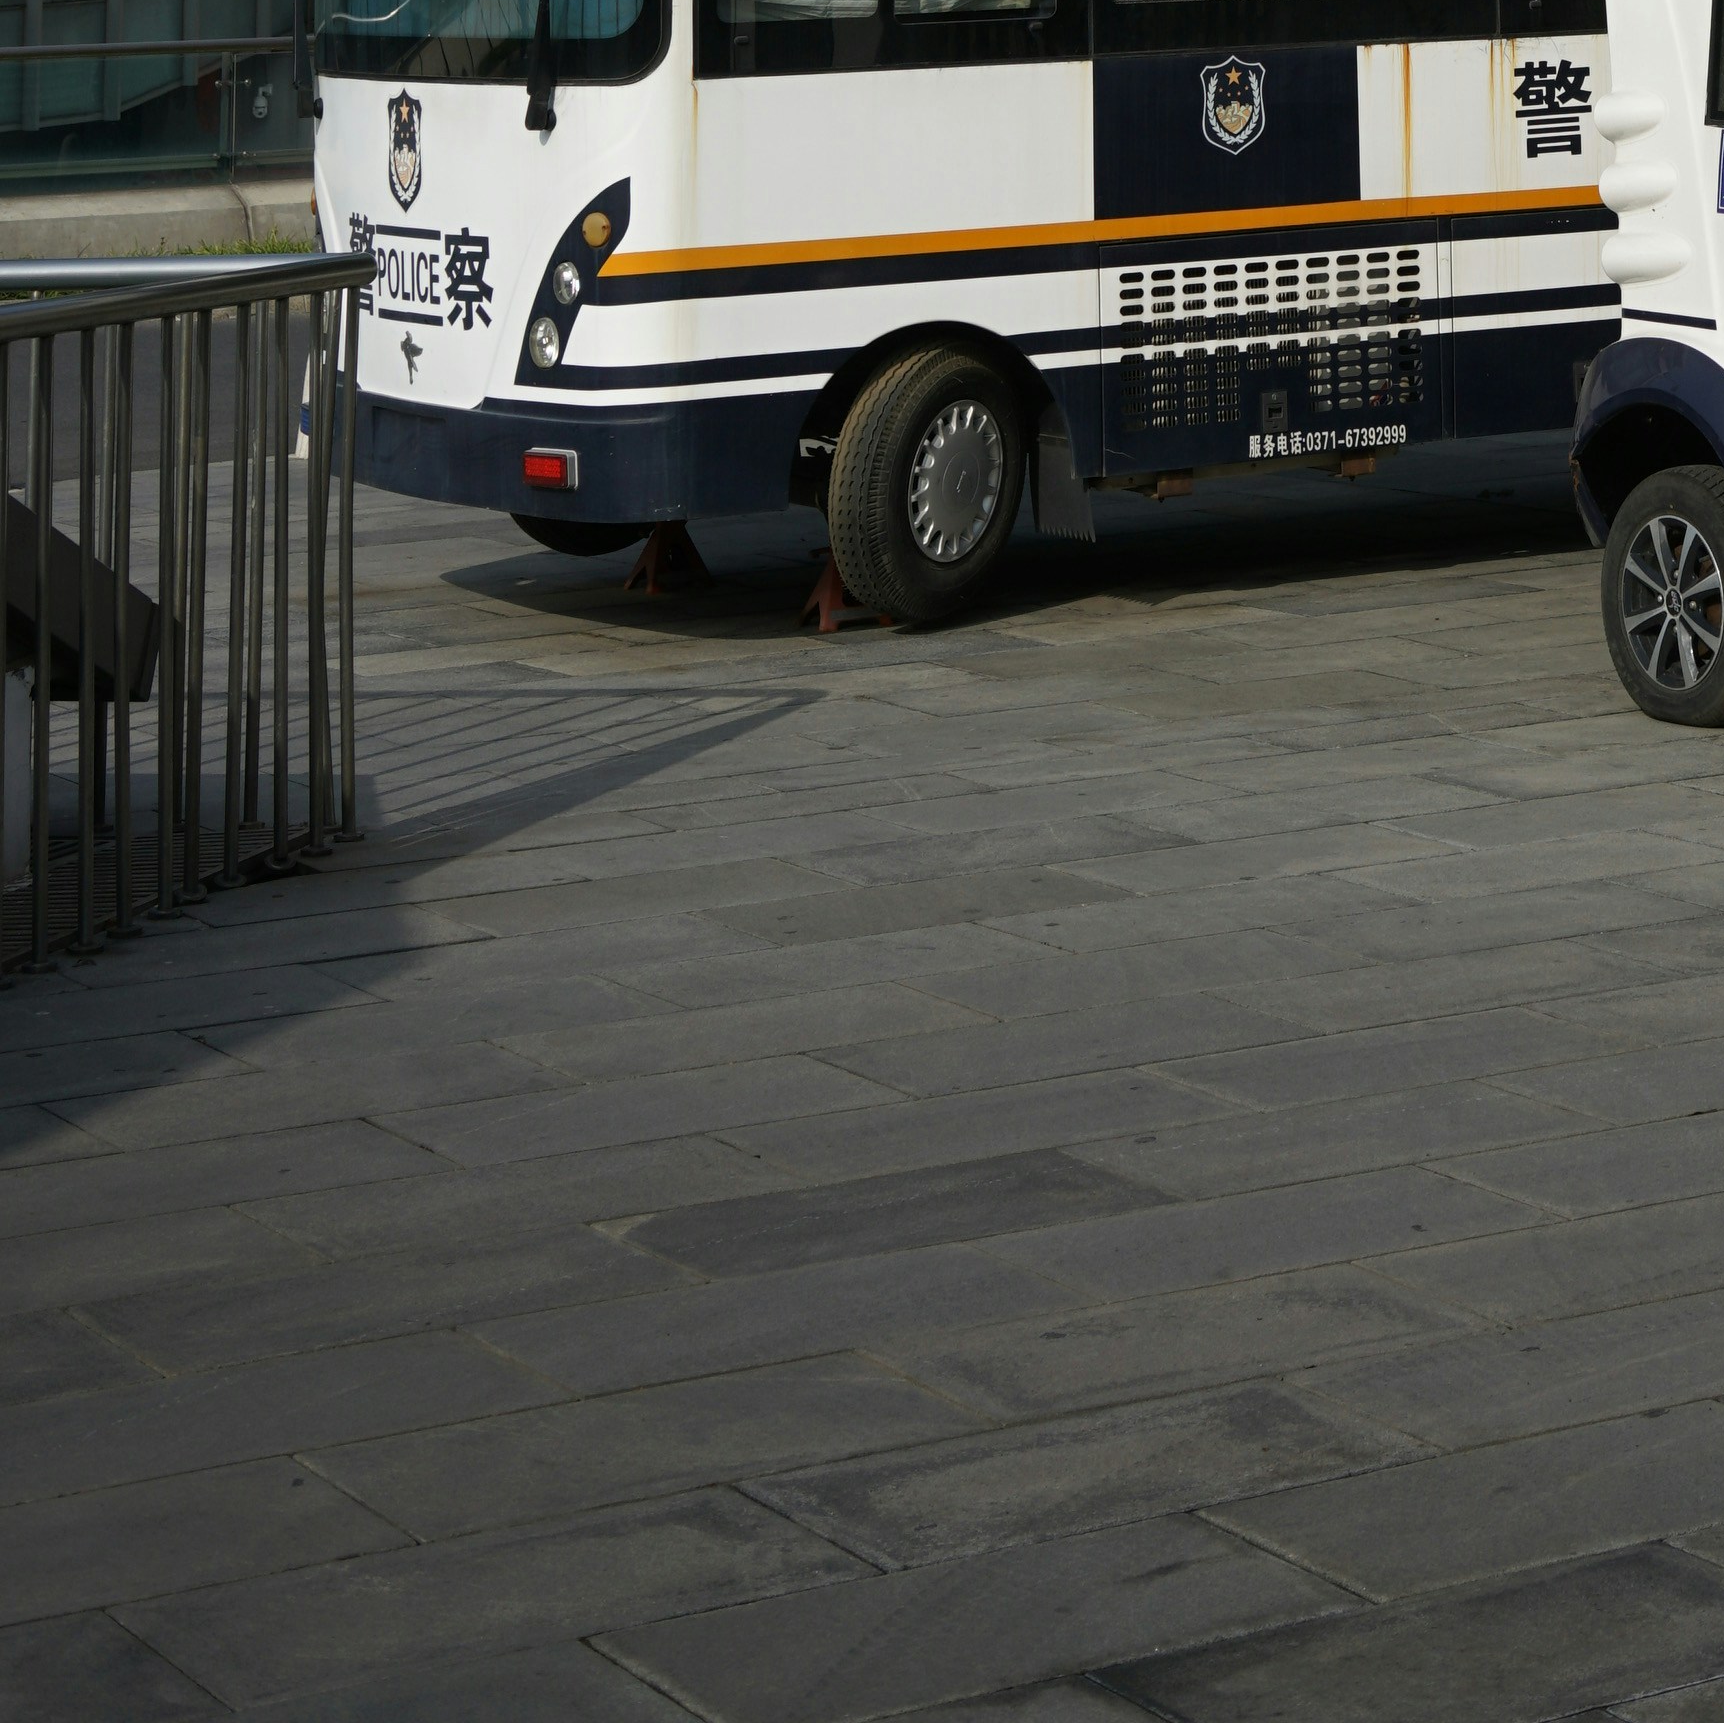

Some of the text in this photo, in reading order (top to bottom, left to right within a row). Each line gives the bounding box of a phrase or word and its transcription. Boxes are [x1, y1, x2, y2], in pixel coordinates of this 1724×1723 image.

[1513, 59, 1593, 159] 警
[377, 247, 441, 305] POLICE
[444, 227, 494, 331] 察
[1248, 424, 1407, 458] 服务电话:0371-67392999
